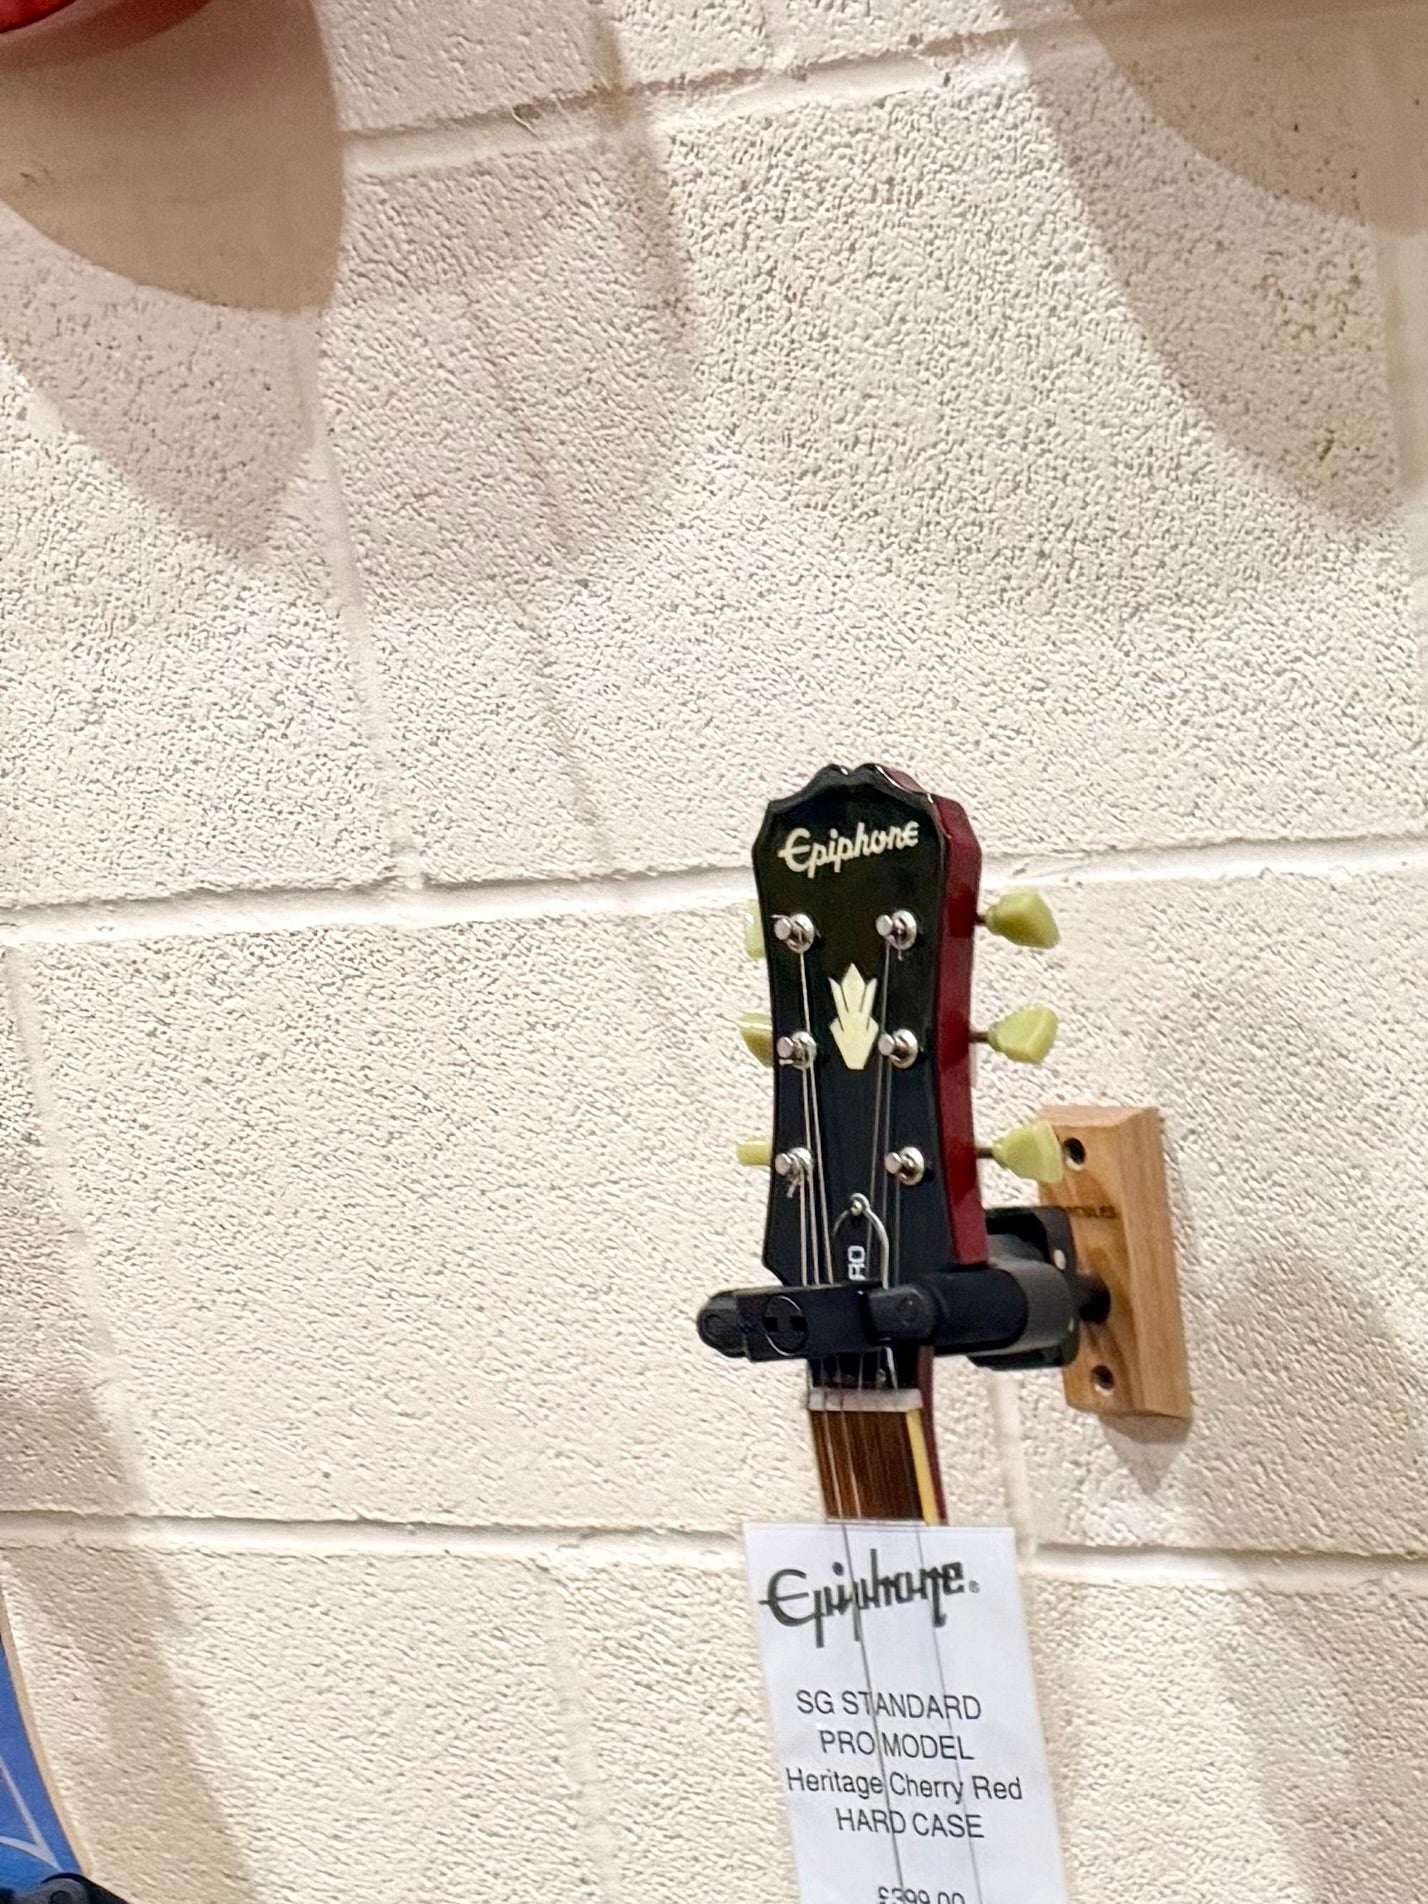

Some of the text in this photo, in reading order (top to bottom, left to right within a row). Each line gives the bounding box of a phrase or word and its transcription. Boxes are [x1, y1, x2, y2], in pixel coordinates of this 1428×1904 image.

[778, 820, 919, 879] Epiphone
[797, 1689, 983, 1722] SG STANDARD
[820, 1730, 975, 1762] PRO MODEL
[787, 1766, 1023, 1805] Heritage Cherry Red
[837, 1807, 985, 1839] HARD CASE
